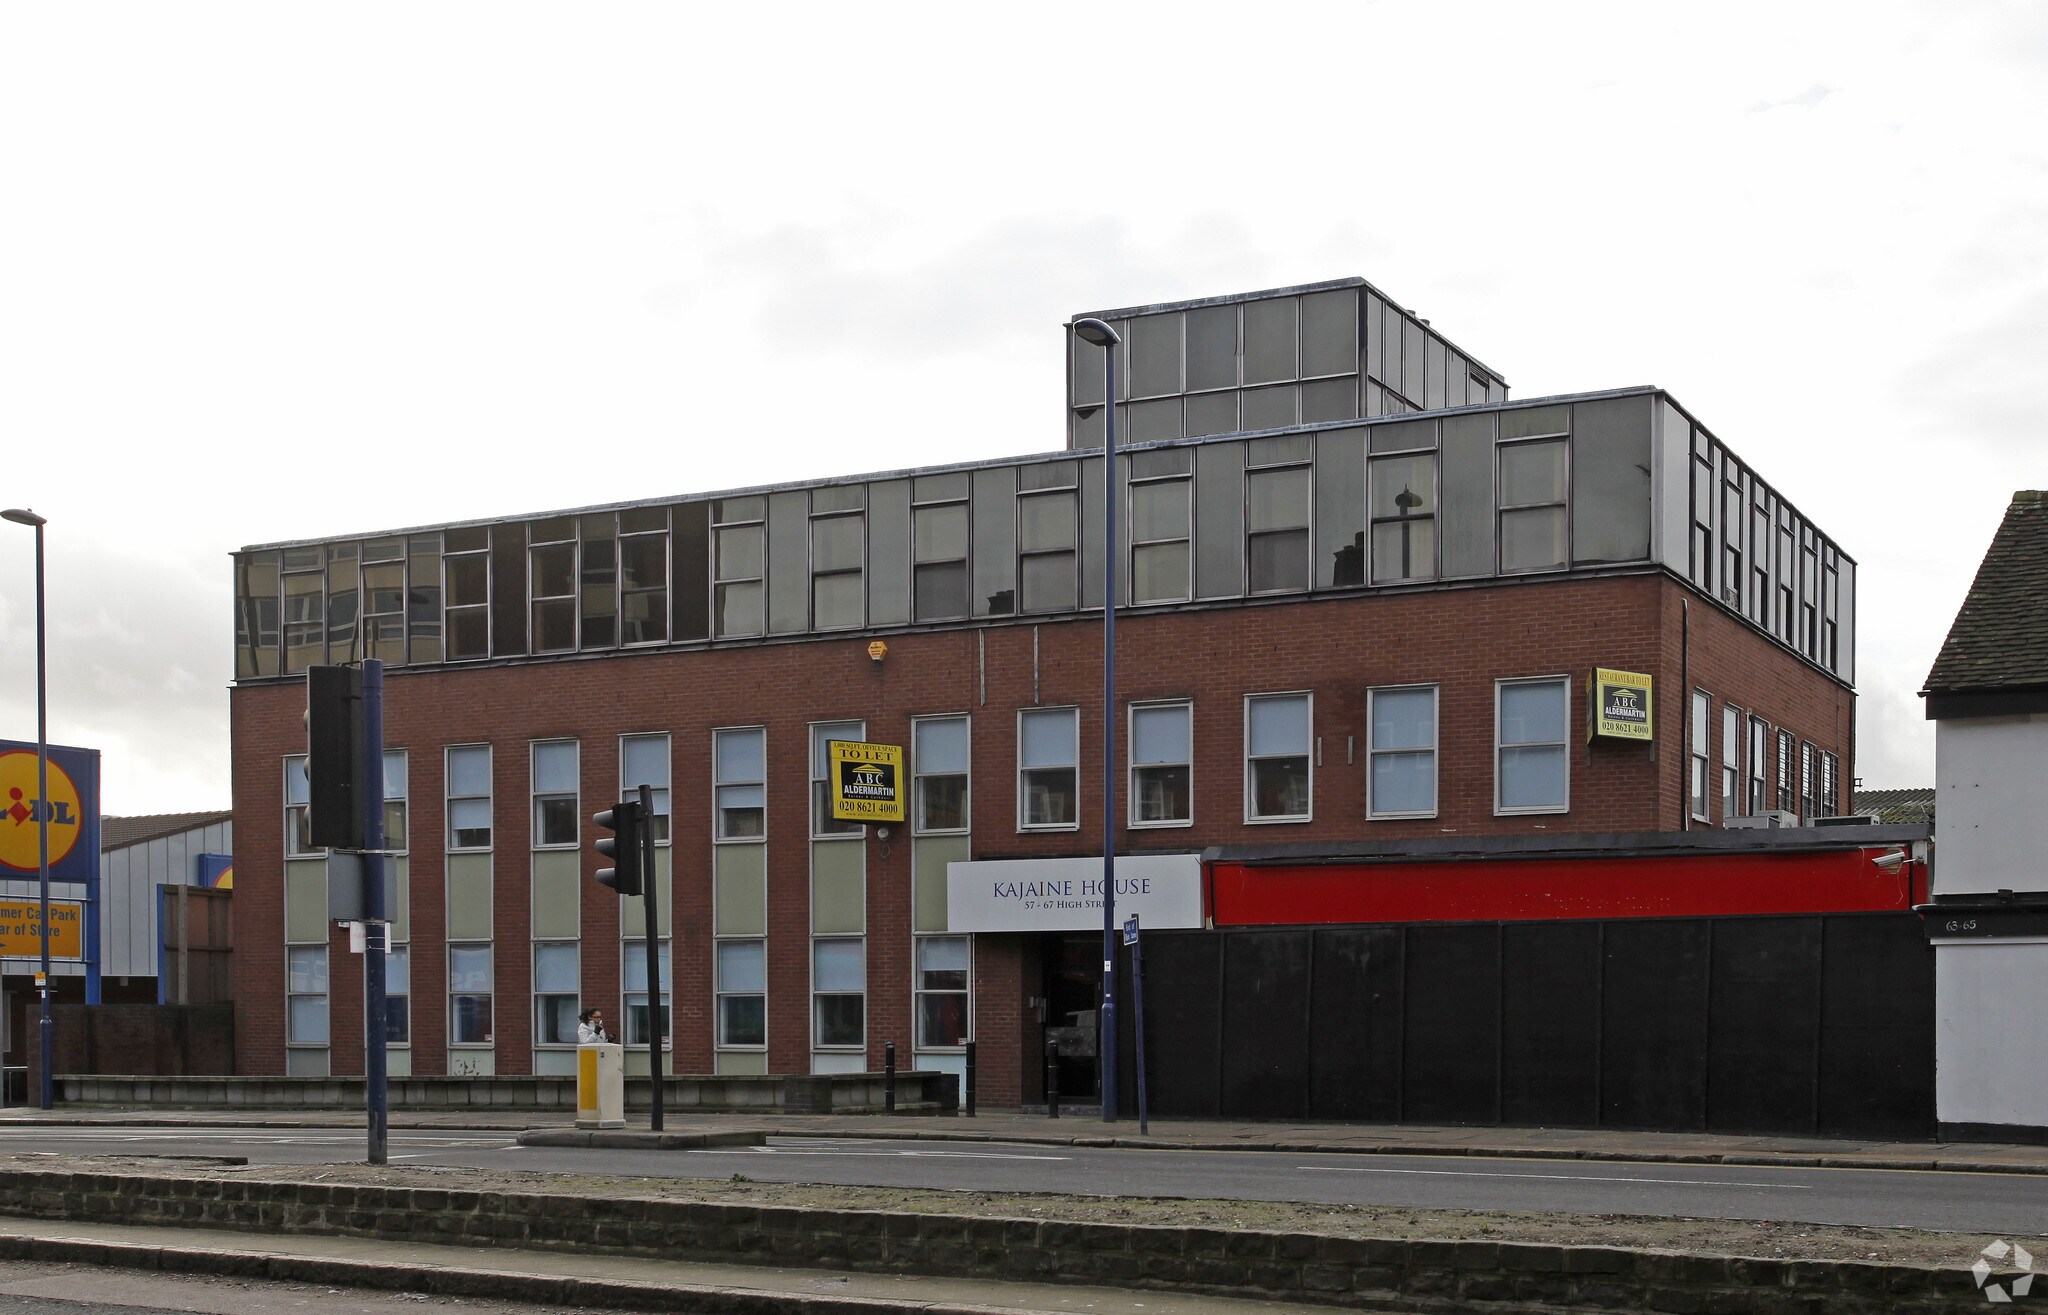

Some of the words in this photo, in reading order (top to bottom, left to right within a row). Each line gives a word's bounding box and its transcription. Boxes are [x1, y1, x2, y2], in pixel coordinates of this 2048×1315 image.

[1605, 706, 1646, 718] ALDERMARTIN
[1602, 721, 1614, 731] 020
[1615, 723, 1631, 732] 8621
[1633, 725, 1649, 735] 4000
[839, 749, 861, 759] TO
[865, 751, 893, 761] LET
[844, 785, 894, 797] ALDERMARTIN
[839, 801, 855, 811] 020
[857, 802, 876, 812] 8621
[879, 803, 898, 813] 4000
[993, 880, 1072, 901] KAJAINE
[1024, 901, 1035, 910] 57
[1043, 901, 1054, 909] 67
[27, 906, 42, 919] Ca
[51, 908, 76, 921] Park
[15, 923, 26, 935] of
[30, 923, 60, 937] Stre
[1946, 920, 1977, 931] 63-65
